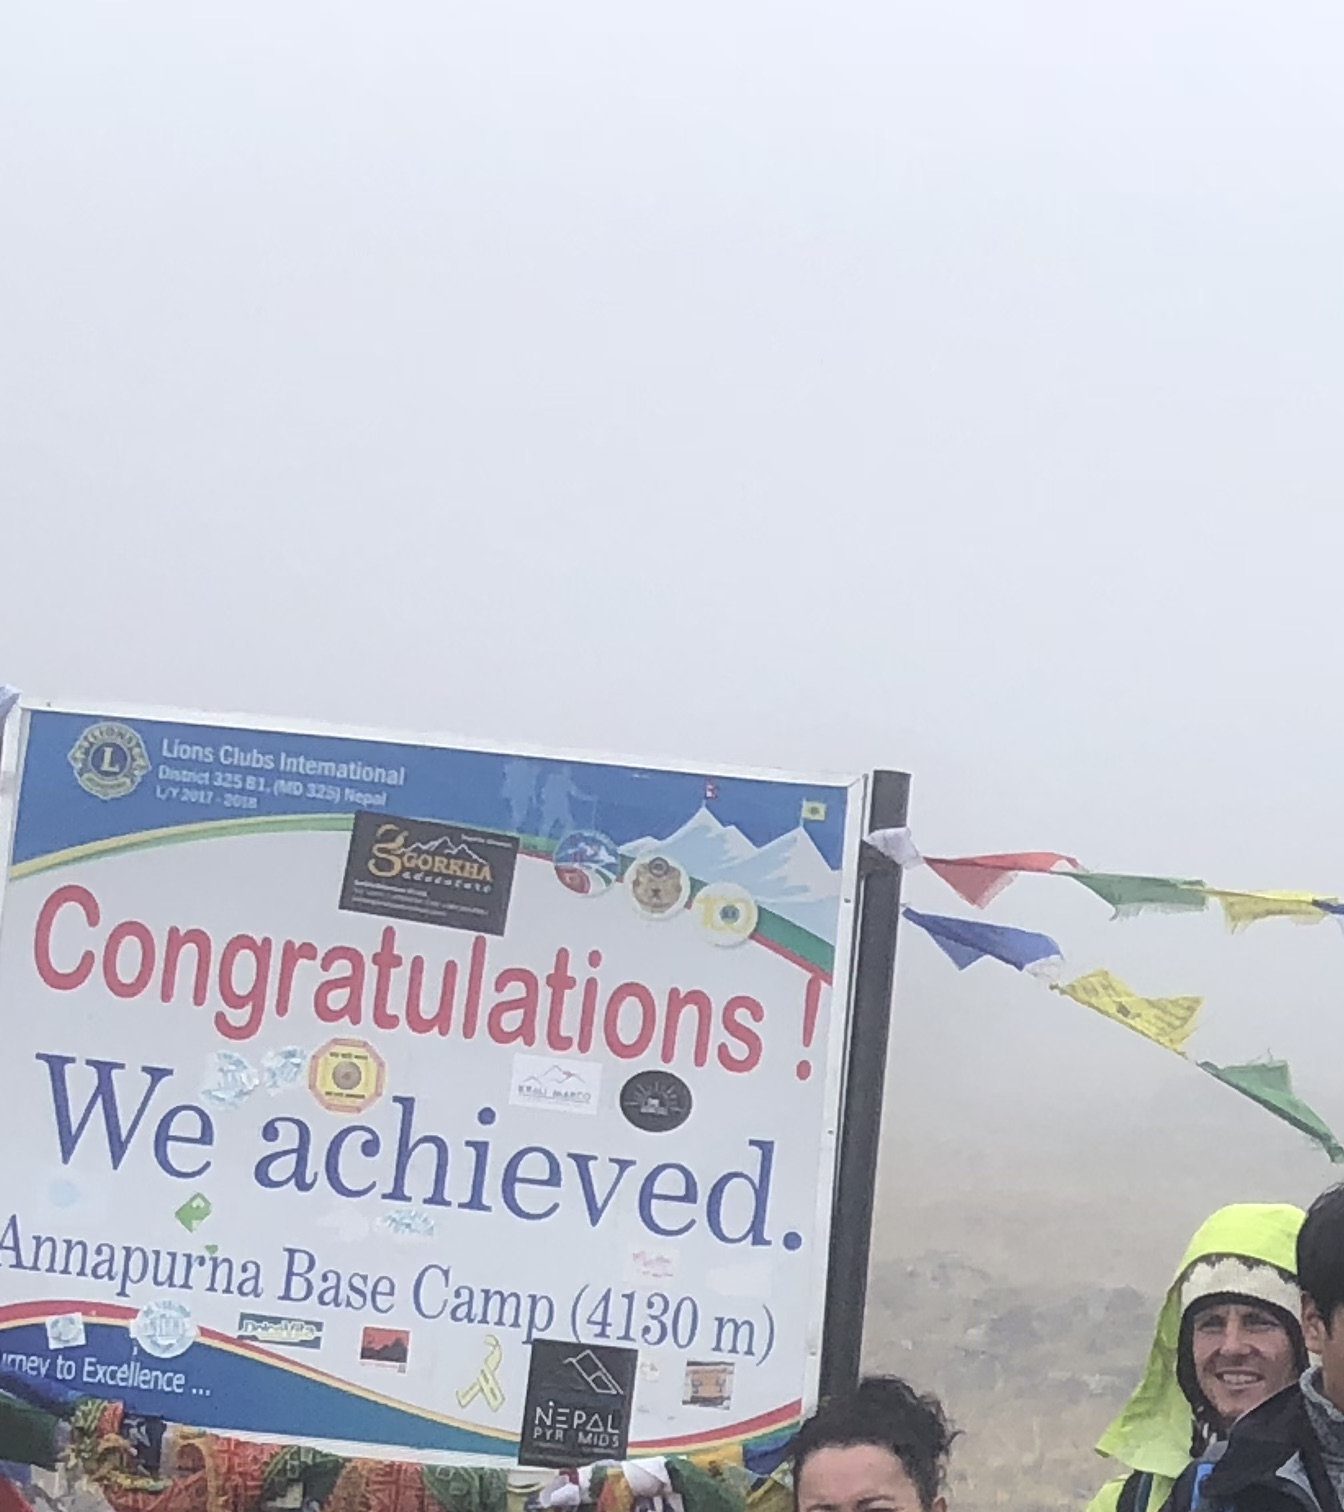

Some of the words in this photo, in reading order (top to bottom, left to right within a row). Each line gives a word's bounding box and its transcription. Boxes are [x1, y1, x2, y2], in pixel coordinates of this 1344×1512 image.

[162, 738, 215, 763] Lions
[219, 745, 275, 770] Clubs
[280, 751, 405, 786] International
[158, 765, 210, 785] District
[344, 787, 387, 807] Nepal
[402, 852, 492, 882] GORKHA
[34, 884, 764, 1073] Congratulations
[35, 1053, 214, 1178] We
[254, 1096, 802, 1251] achieved.
[0, 1214, 263, 1298] Annapurna
[278, 1246, 396, 1313] Base
[413, 1264, 554, 1344] Camp
[571, 1284, 699, 1348] (4130
[712, 1305, 775, 1366] m)
[56, 1354, 76, 1380] to
[83, 1357, 186, 1393] Excellence
[534, 1406, 620, 1434] NEPAL
